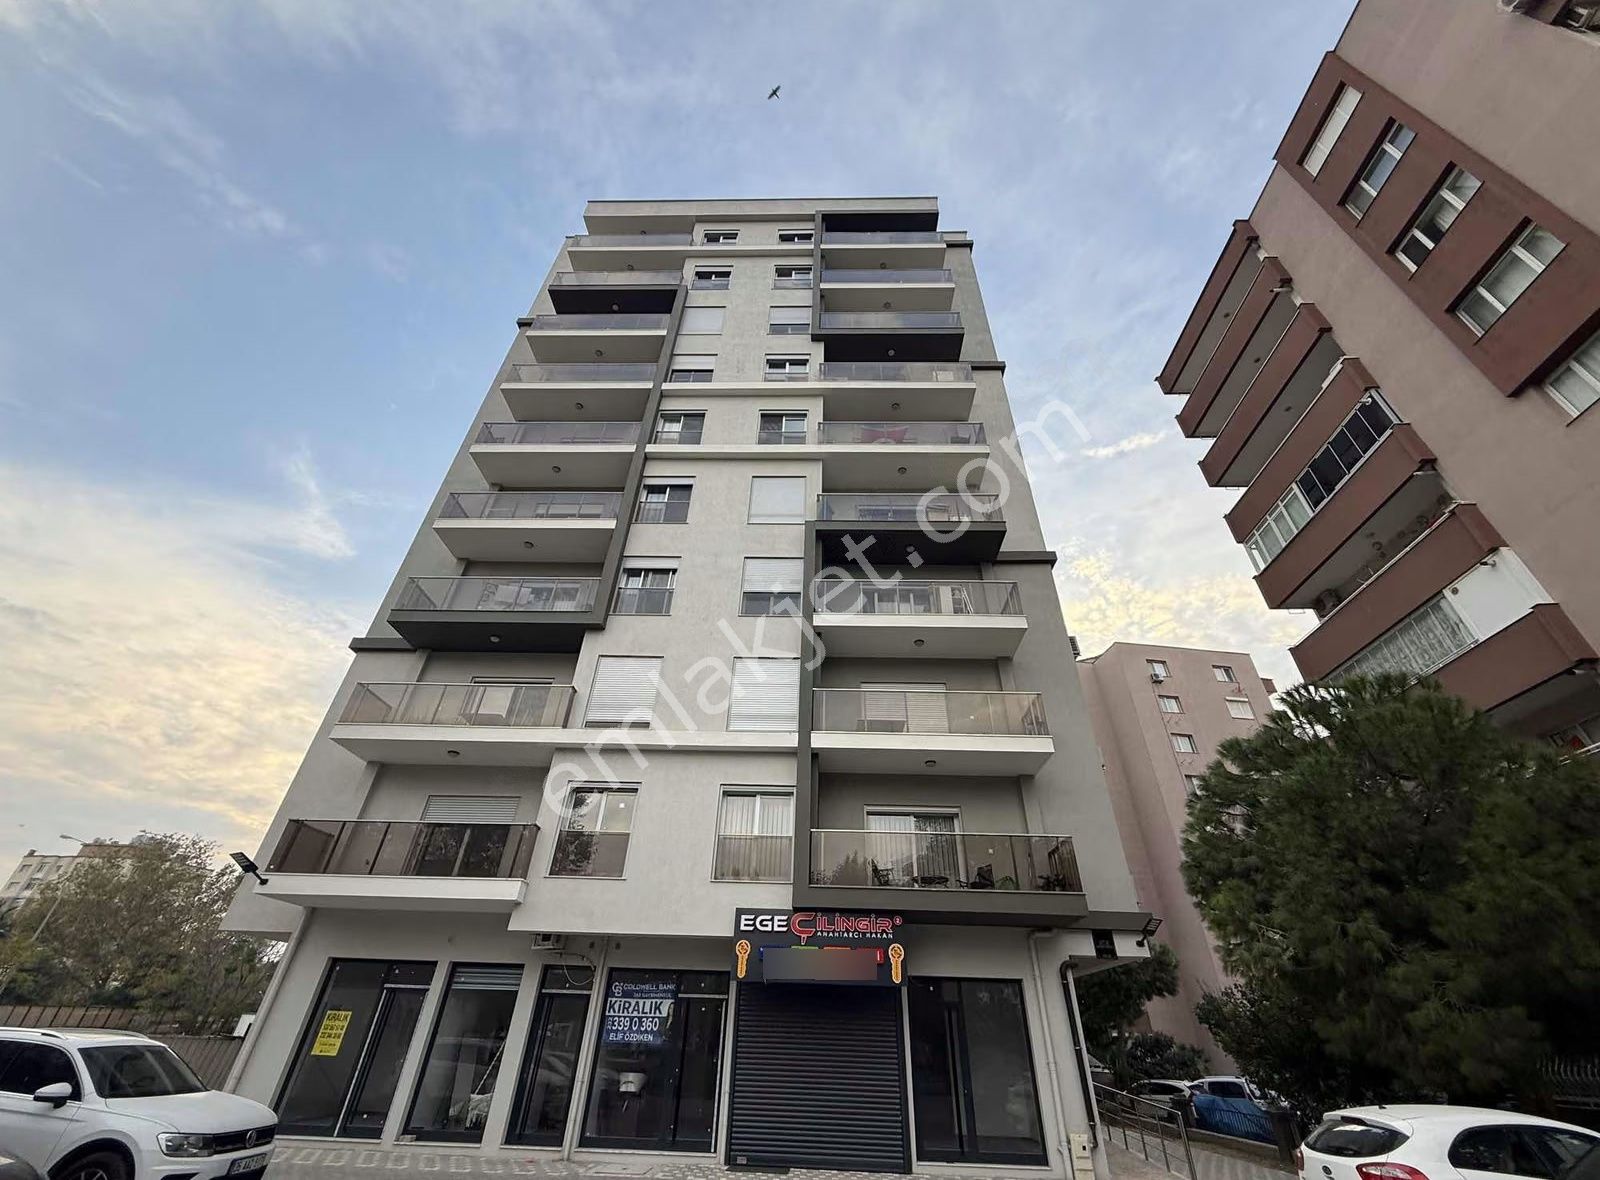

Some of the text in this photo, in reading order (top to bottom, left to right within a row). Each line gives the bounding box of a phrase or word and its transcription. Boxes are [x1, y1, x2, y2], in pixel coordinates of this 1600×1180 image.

[740, 914, 788, 932] EGE
[612, 1017, 630, 1031] 339
[640, 1018, 659, 1031] 360
